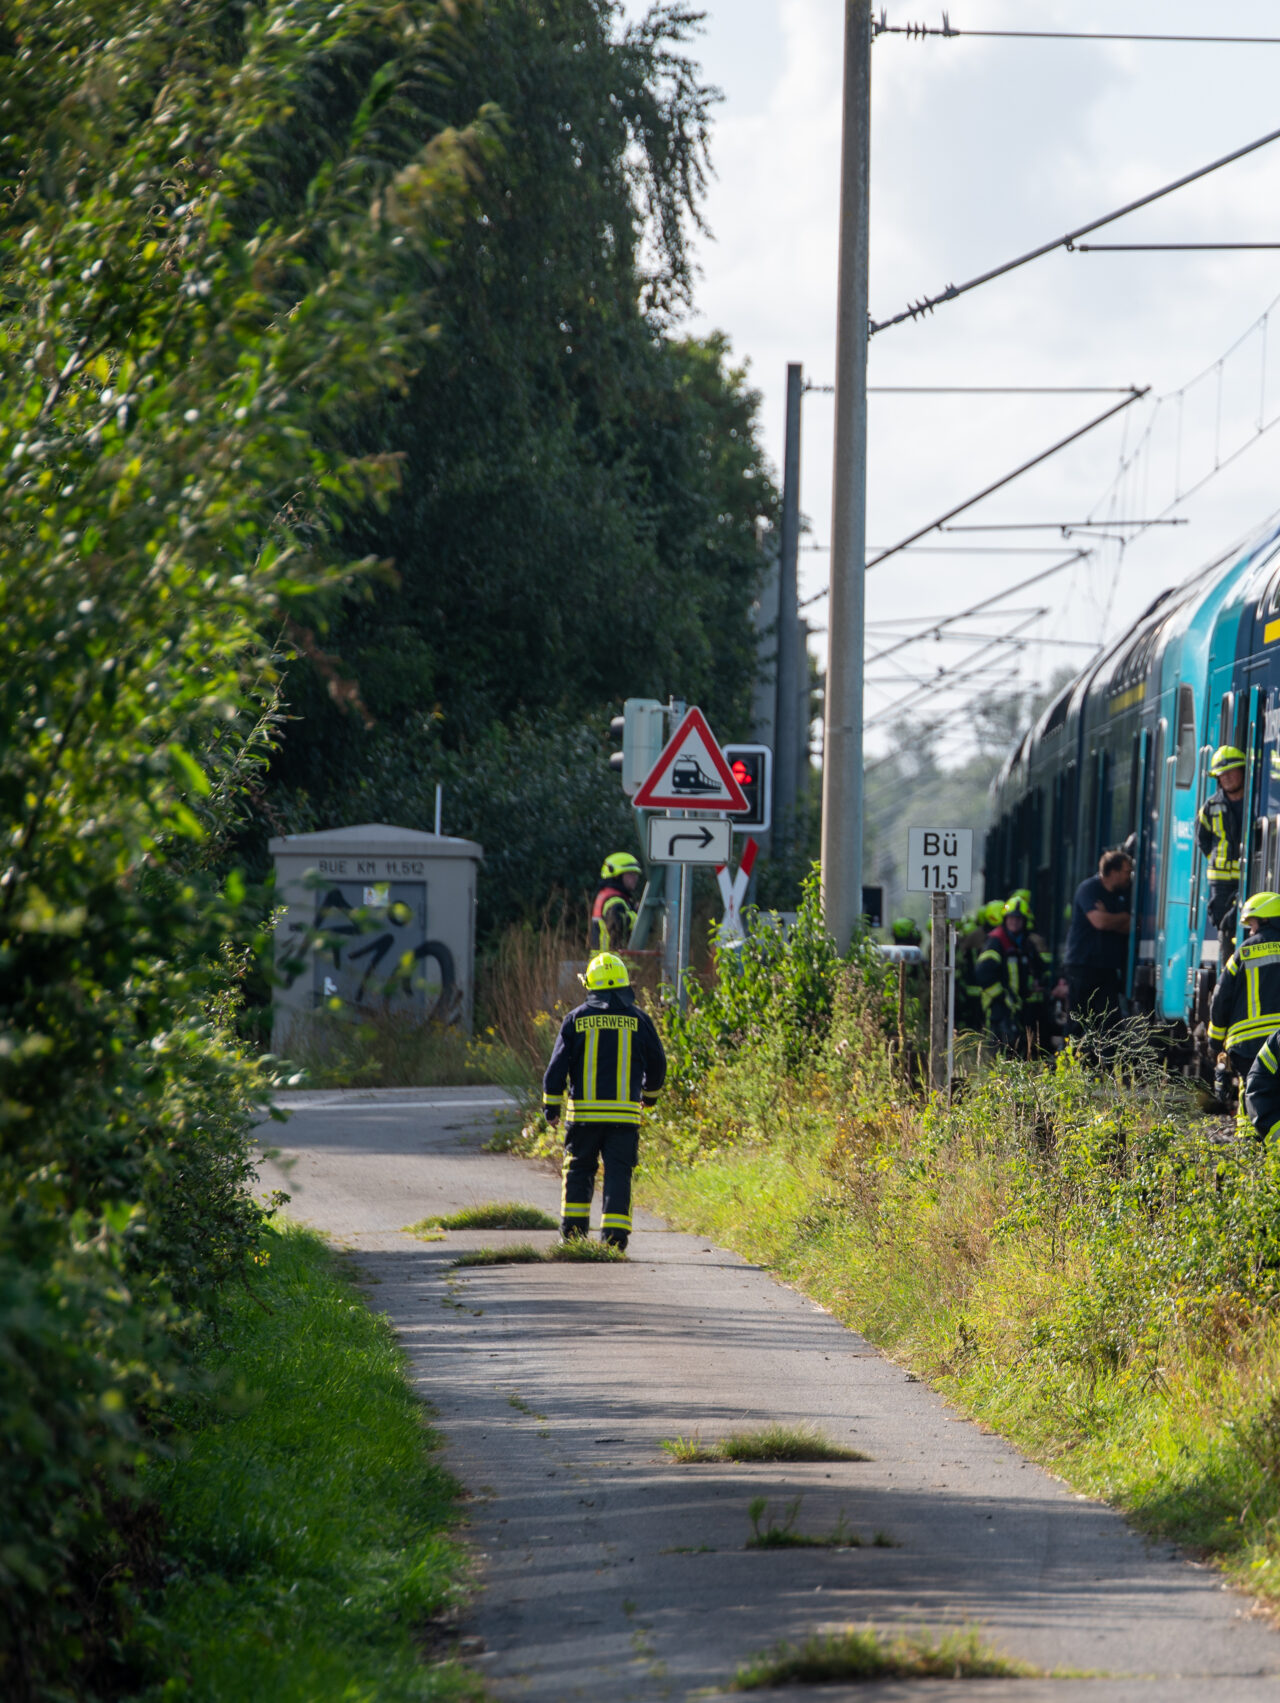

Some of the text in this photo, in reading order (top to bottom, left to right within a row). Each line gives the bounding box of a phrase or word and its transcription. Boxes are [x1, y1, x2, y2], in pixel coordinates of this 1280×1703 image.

[923, 832, 958, 857] Bü
[318, 861, 348, 874] BUE
[356, 862, 377, 875] KM
[921, 864, 959, 890] 11,5
[577, 1015, 636, 1030] FEUERWEHR
